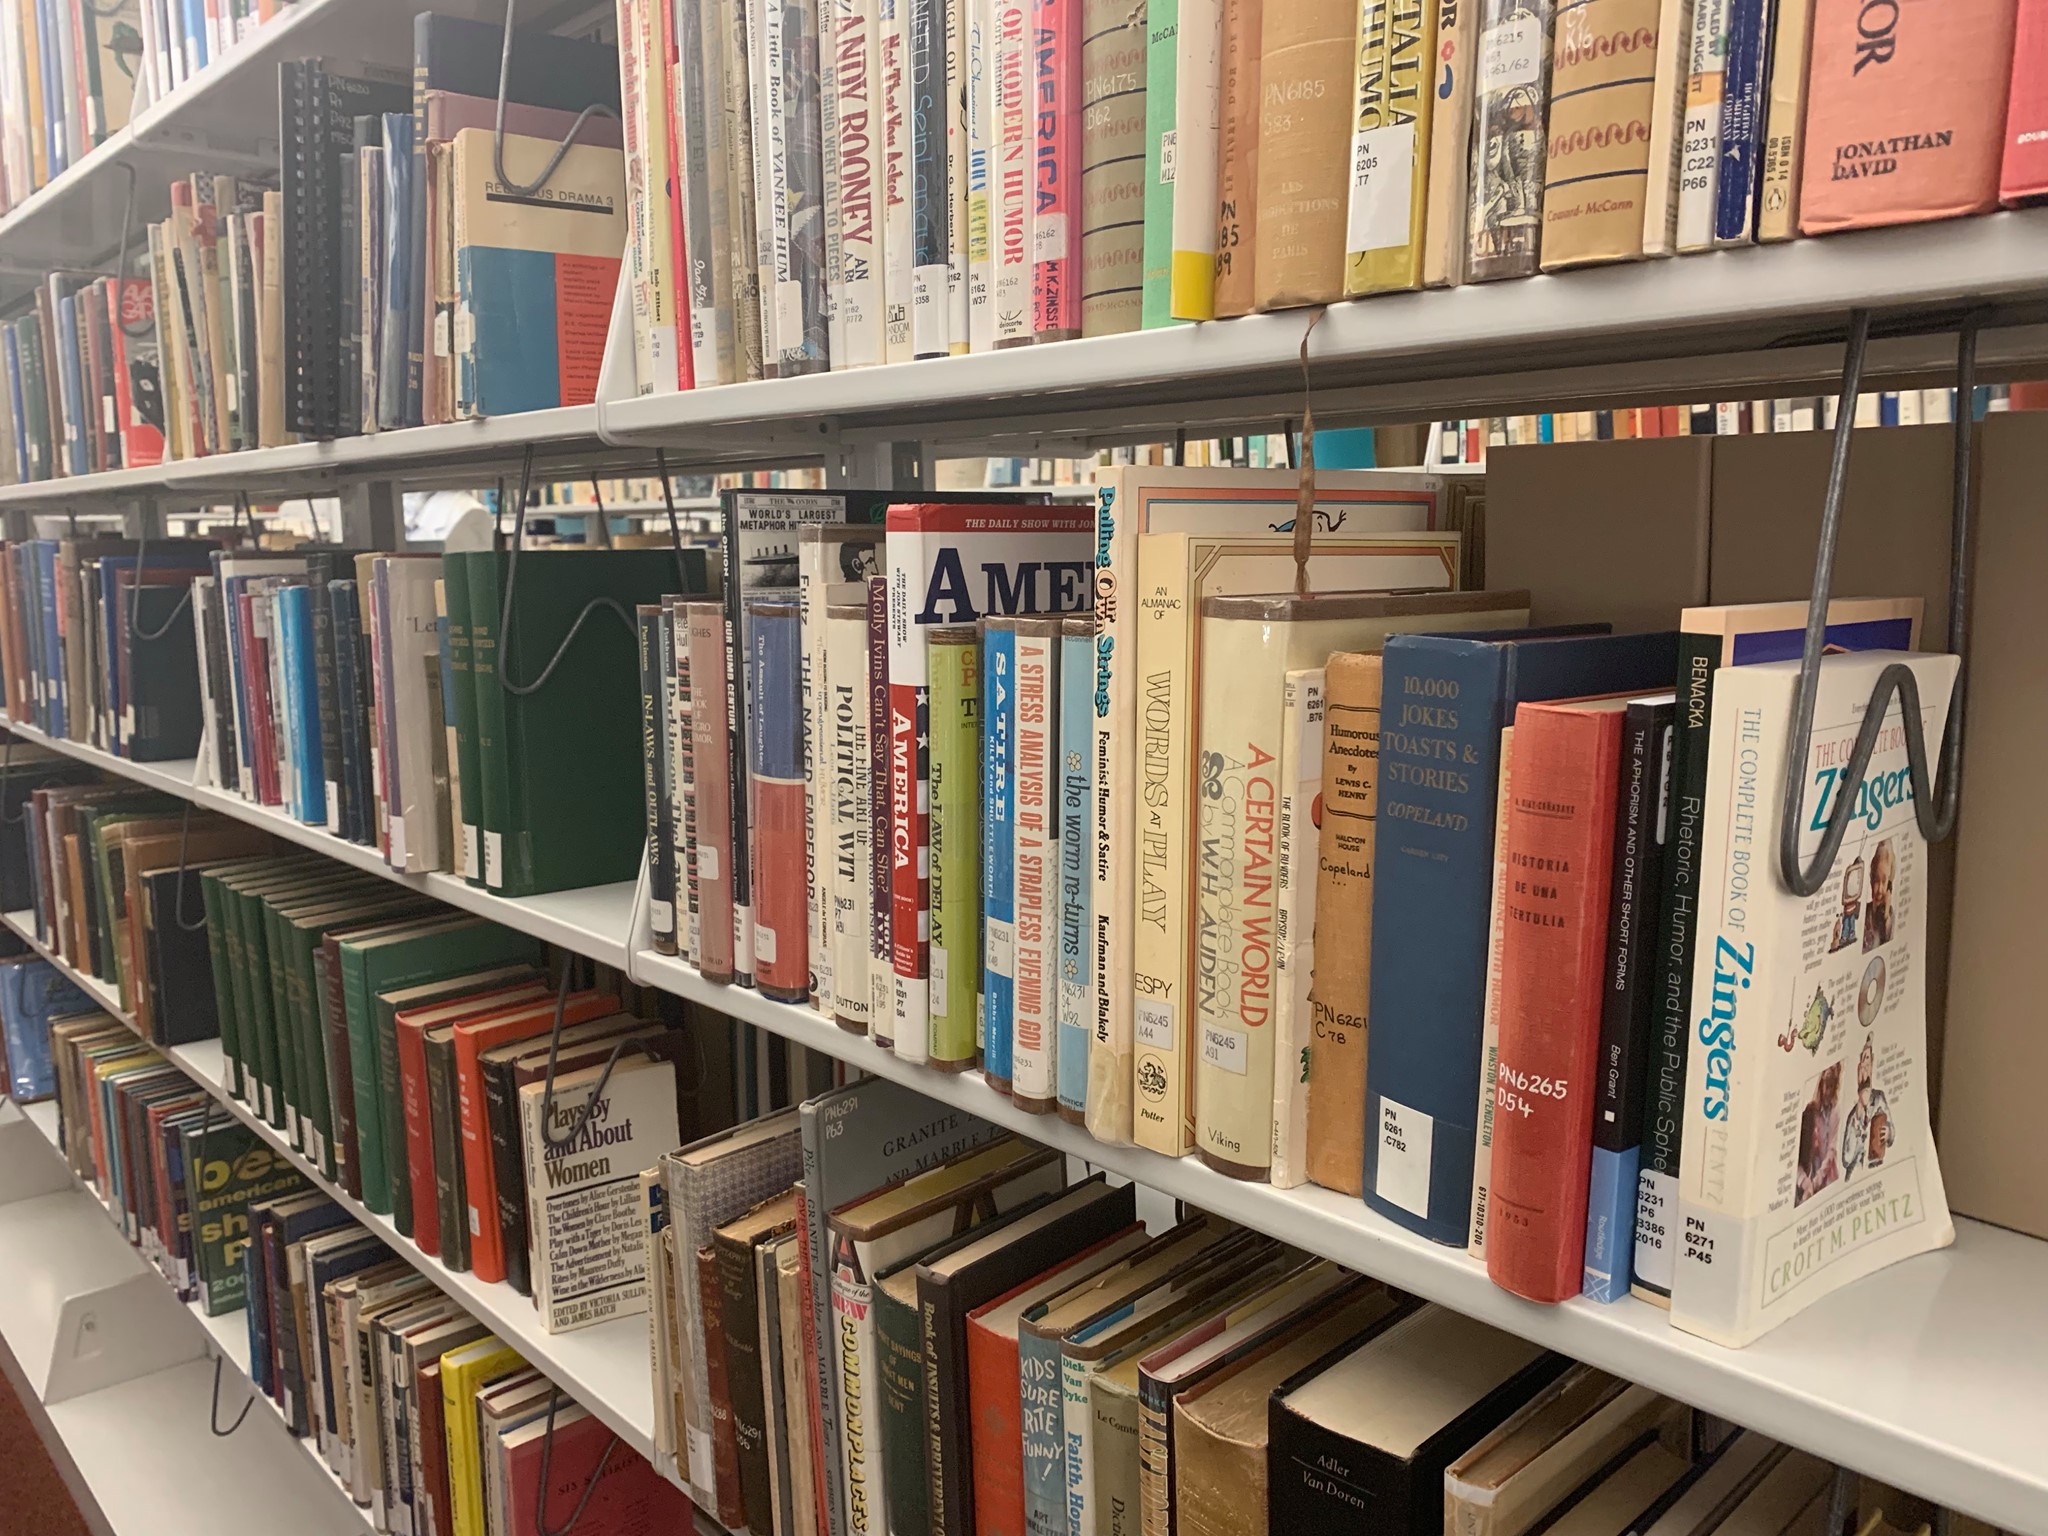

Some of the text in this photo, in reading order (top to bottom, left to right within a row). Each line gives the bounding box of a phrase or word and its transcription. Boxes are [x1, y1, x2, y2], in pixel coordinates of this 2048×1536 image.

[1002, 8, 1023, 42] OF
[1085, 72, 1138, 100] PN6175
[1264, 79, 1326, 107] PN6185
[1002, 51, 1024, 162] MODERN
[835, 15, 873, 245] ANDY ROONEY
[1033, 28, 1057, 214] AMERICA
[1686, 119, 1706, 134] PN
[1357, 143, 1370, 157] PN
[1685, 136, 1717, 153] 6231
[1835, 130, 1954, 163] JONATHAN
[822, 67, 840, 281] MY MIND WENT ALL TO PIECES
[1356, 157, 1378, 172] 6205
[1683, 156, 1715, 173] .C22
[1831, 158, 1898, 181] DAVID
[1681, 175, 1708, 191] P66
[1003, 169, 1024, 266] HUMOR
[971, 273, 979, 281] PN
[739, 520, 786, 531] METAPHOR
[749, 509, 837, 520] WORLD'S LARGEST
[1141, 598, 1182, 610] ALMANAC
[1155, 586, 1168, 597] AN
[1153, 609, 1166, 621] OF
[725, 620, 737, 733] OUR DUMB CENTURY
[1307, 687, 1319, 697] PN
[1307, 698, 1324, 710] 6261
[1687, 655, 1710, 729] BENACKA
[1398, 703, 1459, 731] JOKES
[870, 583, 889, 893] Molly Ivins Can't Say That, Can She?
[1329, 724, 1381, 742] Humorous
[1328, 741, 1380, 760] Anecdotes
[1383, 731, 1480, 765] TOASTS &
[1815, 741, 1837, 769] THE
[801, 652, 817, 900] THE NAKED EMPEROR
[892, 707, 912, 870] AMERICA
[1335, 777, 1373, 790] LEWIS C.
[1387, 762, 1470, 794] STORIES
[1098, 730, 1111, 882] Feminist Humor & Satire
[1337, 789, 1368, 801] HENRY
[1386, 801, 1469, 833] COPELAND
[1727, 708, 1762, 933] THE COMPLETE BOOK OF
[1335, 833, 1366, 845] HALCYON
[1337, 843, 1361, 853] HOUSE
[1673, 795, 1700, 888] Rhetoric,
[931, 762, 943, 947] The LAW of DELAY
[1511, 851, 1570, 874] HISTORIA
[1615, 730, 1646, 991] THE APHORISM AND OTHER SHORT FORMS
[1319, 857, 1371, 880] Copeland
[1239, 741, 1276, 1028] A CERTAIN WORLD
[1199, 803, 1221, 1016] by W.H. AUDEN
[1509, 905, 1566, 929] TERTULIA
[1667, 892, 1694, 968] Humor,
[1061, 982, 1086, 999] PN6231
[1096, 914, 1110, 1043] Kaufman and Blakely
[1134, 972, 1173, 999] ESPY
[835, 995, 868, 1012] DUTTON
[1664, 971, 1684, 1014] and
[1314, 1001, 1368, 1030] PN6261
[1698, 934, 1755, 1123] Zingers
[1138, 1024, 1154, 1040] A44
[1205, 1029, 1236, 1050] PN6245
[1662, 1013, 1684, 1048] the
[1498, 1063, 1569, 1100] PN6265
[1606, 1044, 1622, 1099] Ben Grant
[1657, 1051, 1682, 1114] Public
[824, 1097, 859, 1123] PN6291
[1140, 1107, 1165, 1123] Potter
[1384, 1107, 1398, 1121] PN
[1498, 1088, 1534, 1119] D54
[825, 1120, 844, 1141] P63
[882, 1113, 959, 1158] GRANITE
[1207, 1126, 1241, 1152] Viking
[1384, 1121, 1404, 1137] 6261
[1383, 1134, 1408, 1152] .C782
[545, 1156, 611, 1190] Women
[1639, 1176, 1656, 1190] PN
[198, 1173, 300, 1212] american
[1637, 1189, 1665, 1208] 6231
[548, 1205, 636, 1238] The Women by Clare Boothe
[1474, 1185, 1487, 1246] 671-10310-200
[1686, 1216, 1706, 1232] PN
[1635, 1232, 1663, 1250] 2016
[1685, 1232, 1715, 1251] 6271
[1769, 1236, 1826, 1294] CROFT
[1829, 1226, 1847, 1254] M.
[1851, 1193, 1915, 1242] PENTZ
[550, 1249, 612, 1273] The Advertisement
[1683, 1248, 1713, 1265] .P45
[553, 1292, 621, 1319] EDITED BY VICTORIA
[554, 1303, 617, 1329] AND JAMES HATCH
[1020, 1356, 1056, 1380] KIDS
[1062, 1355, 1086, 1373] Dick
[1020, 1379, 1061, 1409] SURE
[1063, 1373, 1083, 1388] Van
[1062, 1388, 1089, 1405] Dyke
[840, 1314, 870, 1533] COMMONPLACES
[1023, 1407, 1058, 1436] RITE
[1021, 1432, 1064, 1461] FUNNY
[1316, 1454, 1351, 1478] Adler
[1302, 1470, 1366, 1510] Van Doren
